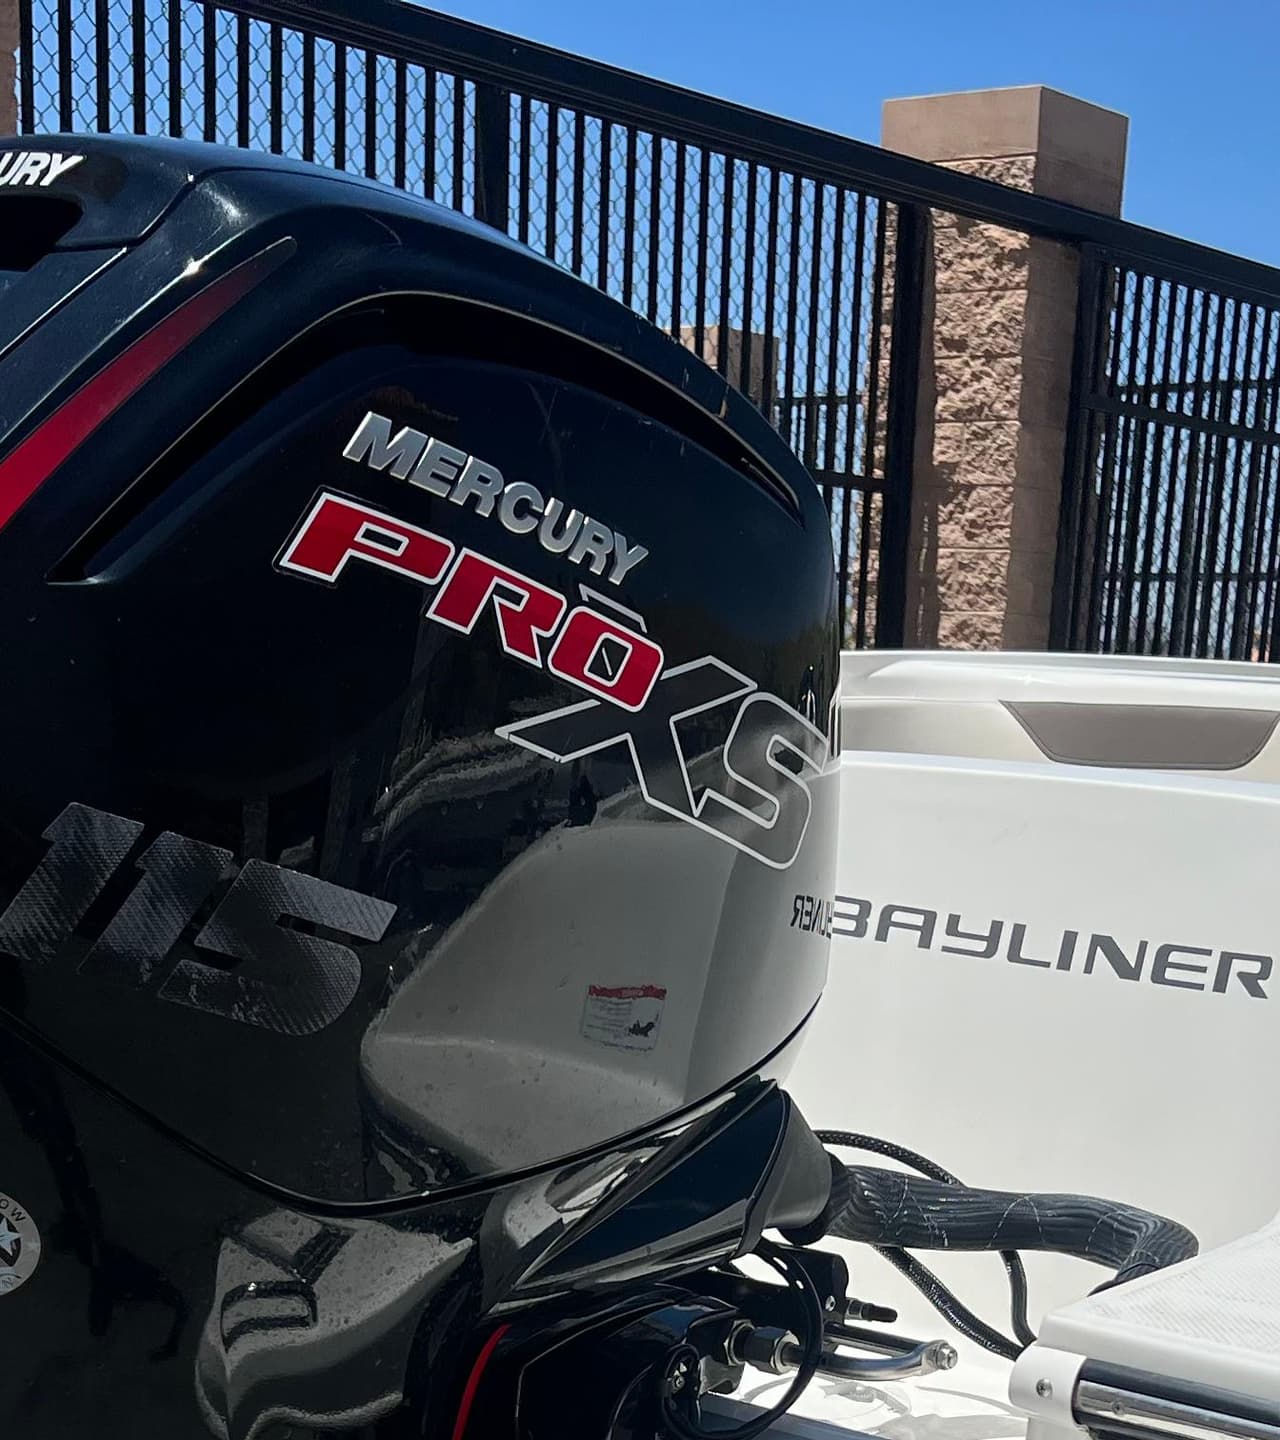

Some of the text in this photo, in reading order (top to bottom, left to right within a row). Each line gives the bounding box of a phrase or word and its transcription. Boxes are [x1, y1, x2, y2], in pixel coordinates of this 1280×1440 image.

[342, 411, 649, 585] MERCURY
[278, 491, 830, 869] PRO XS
[830, 895, 1273, 999] BAYLINER
